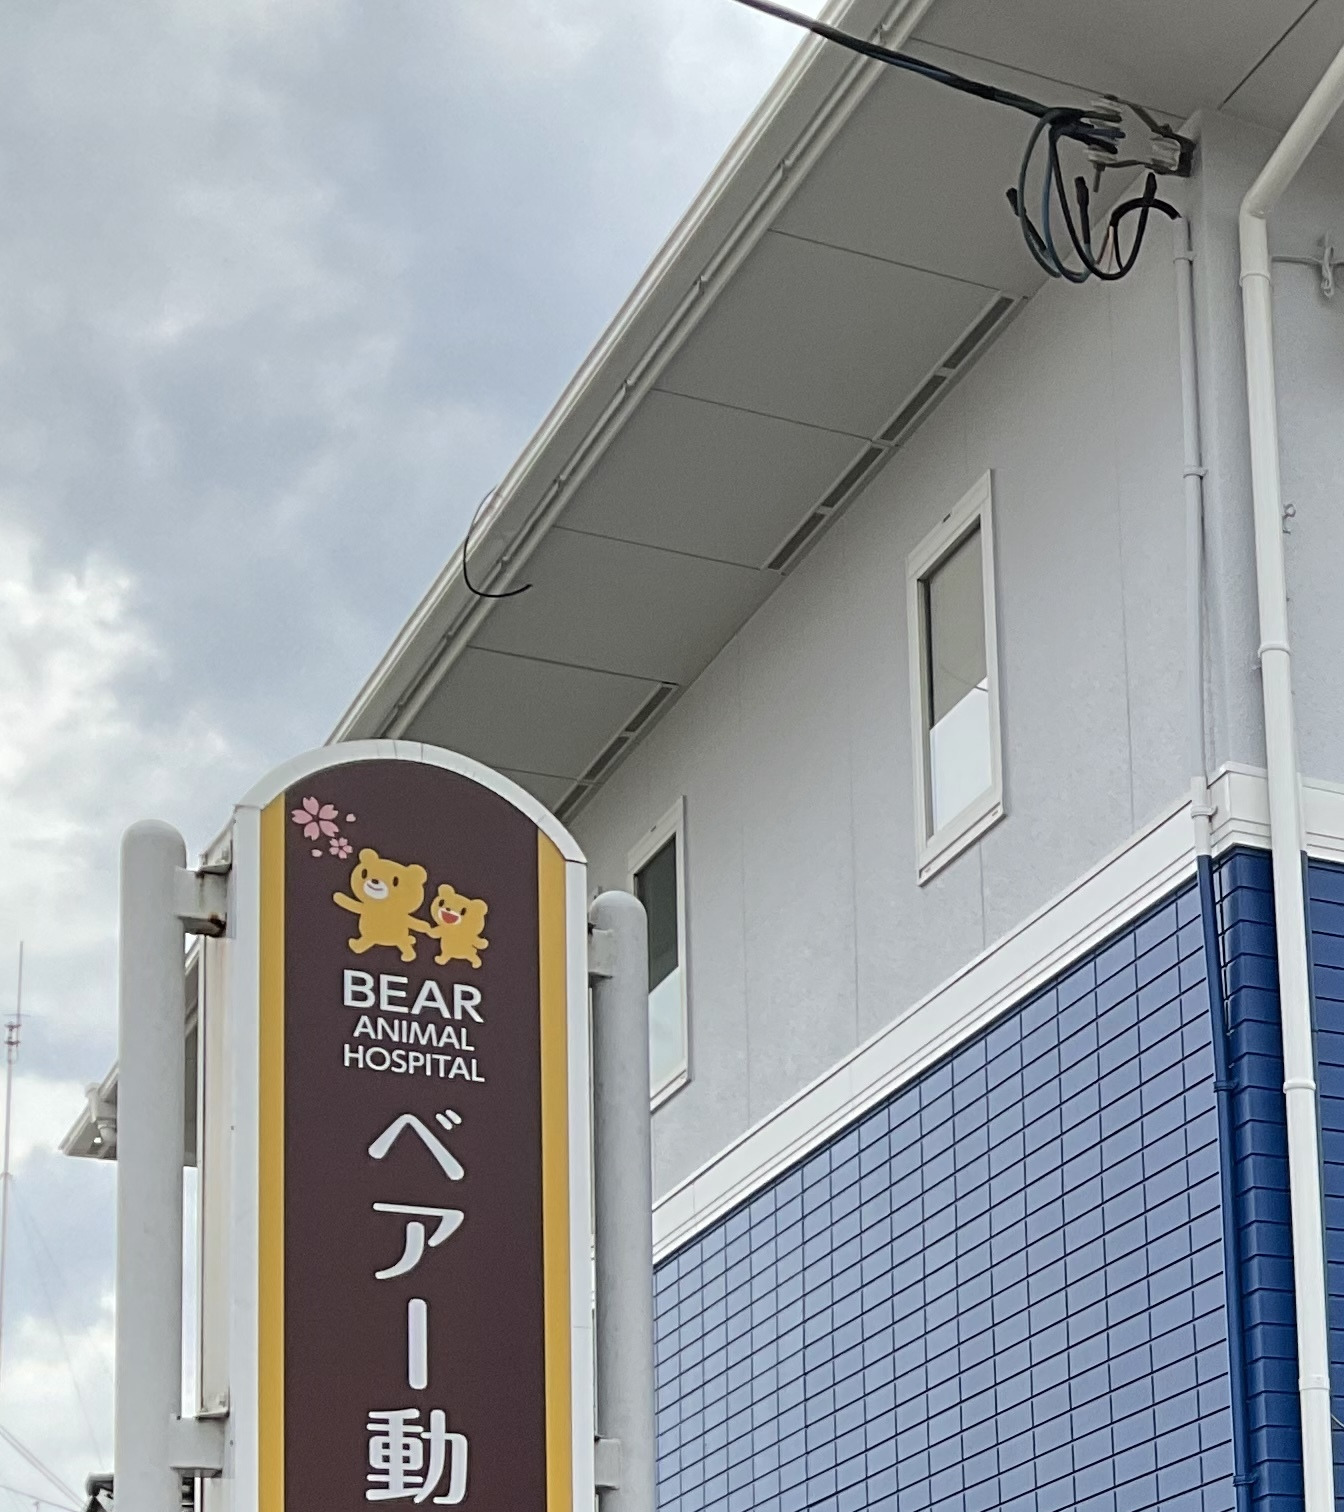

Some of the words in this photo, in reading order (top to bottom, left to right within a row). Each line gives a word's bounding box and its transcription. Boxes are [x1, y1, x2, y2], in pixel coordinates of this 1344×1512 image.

[343, 969, 484, 1023] BEAR
[353, 1015, 475, 1052] ANIMAL
[343, 1043, 486, 1083] HOSPITAL
